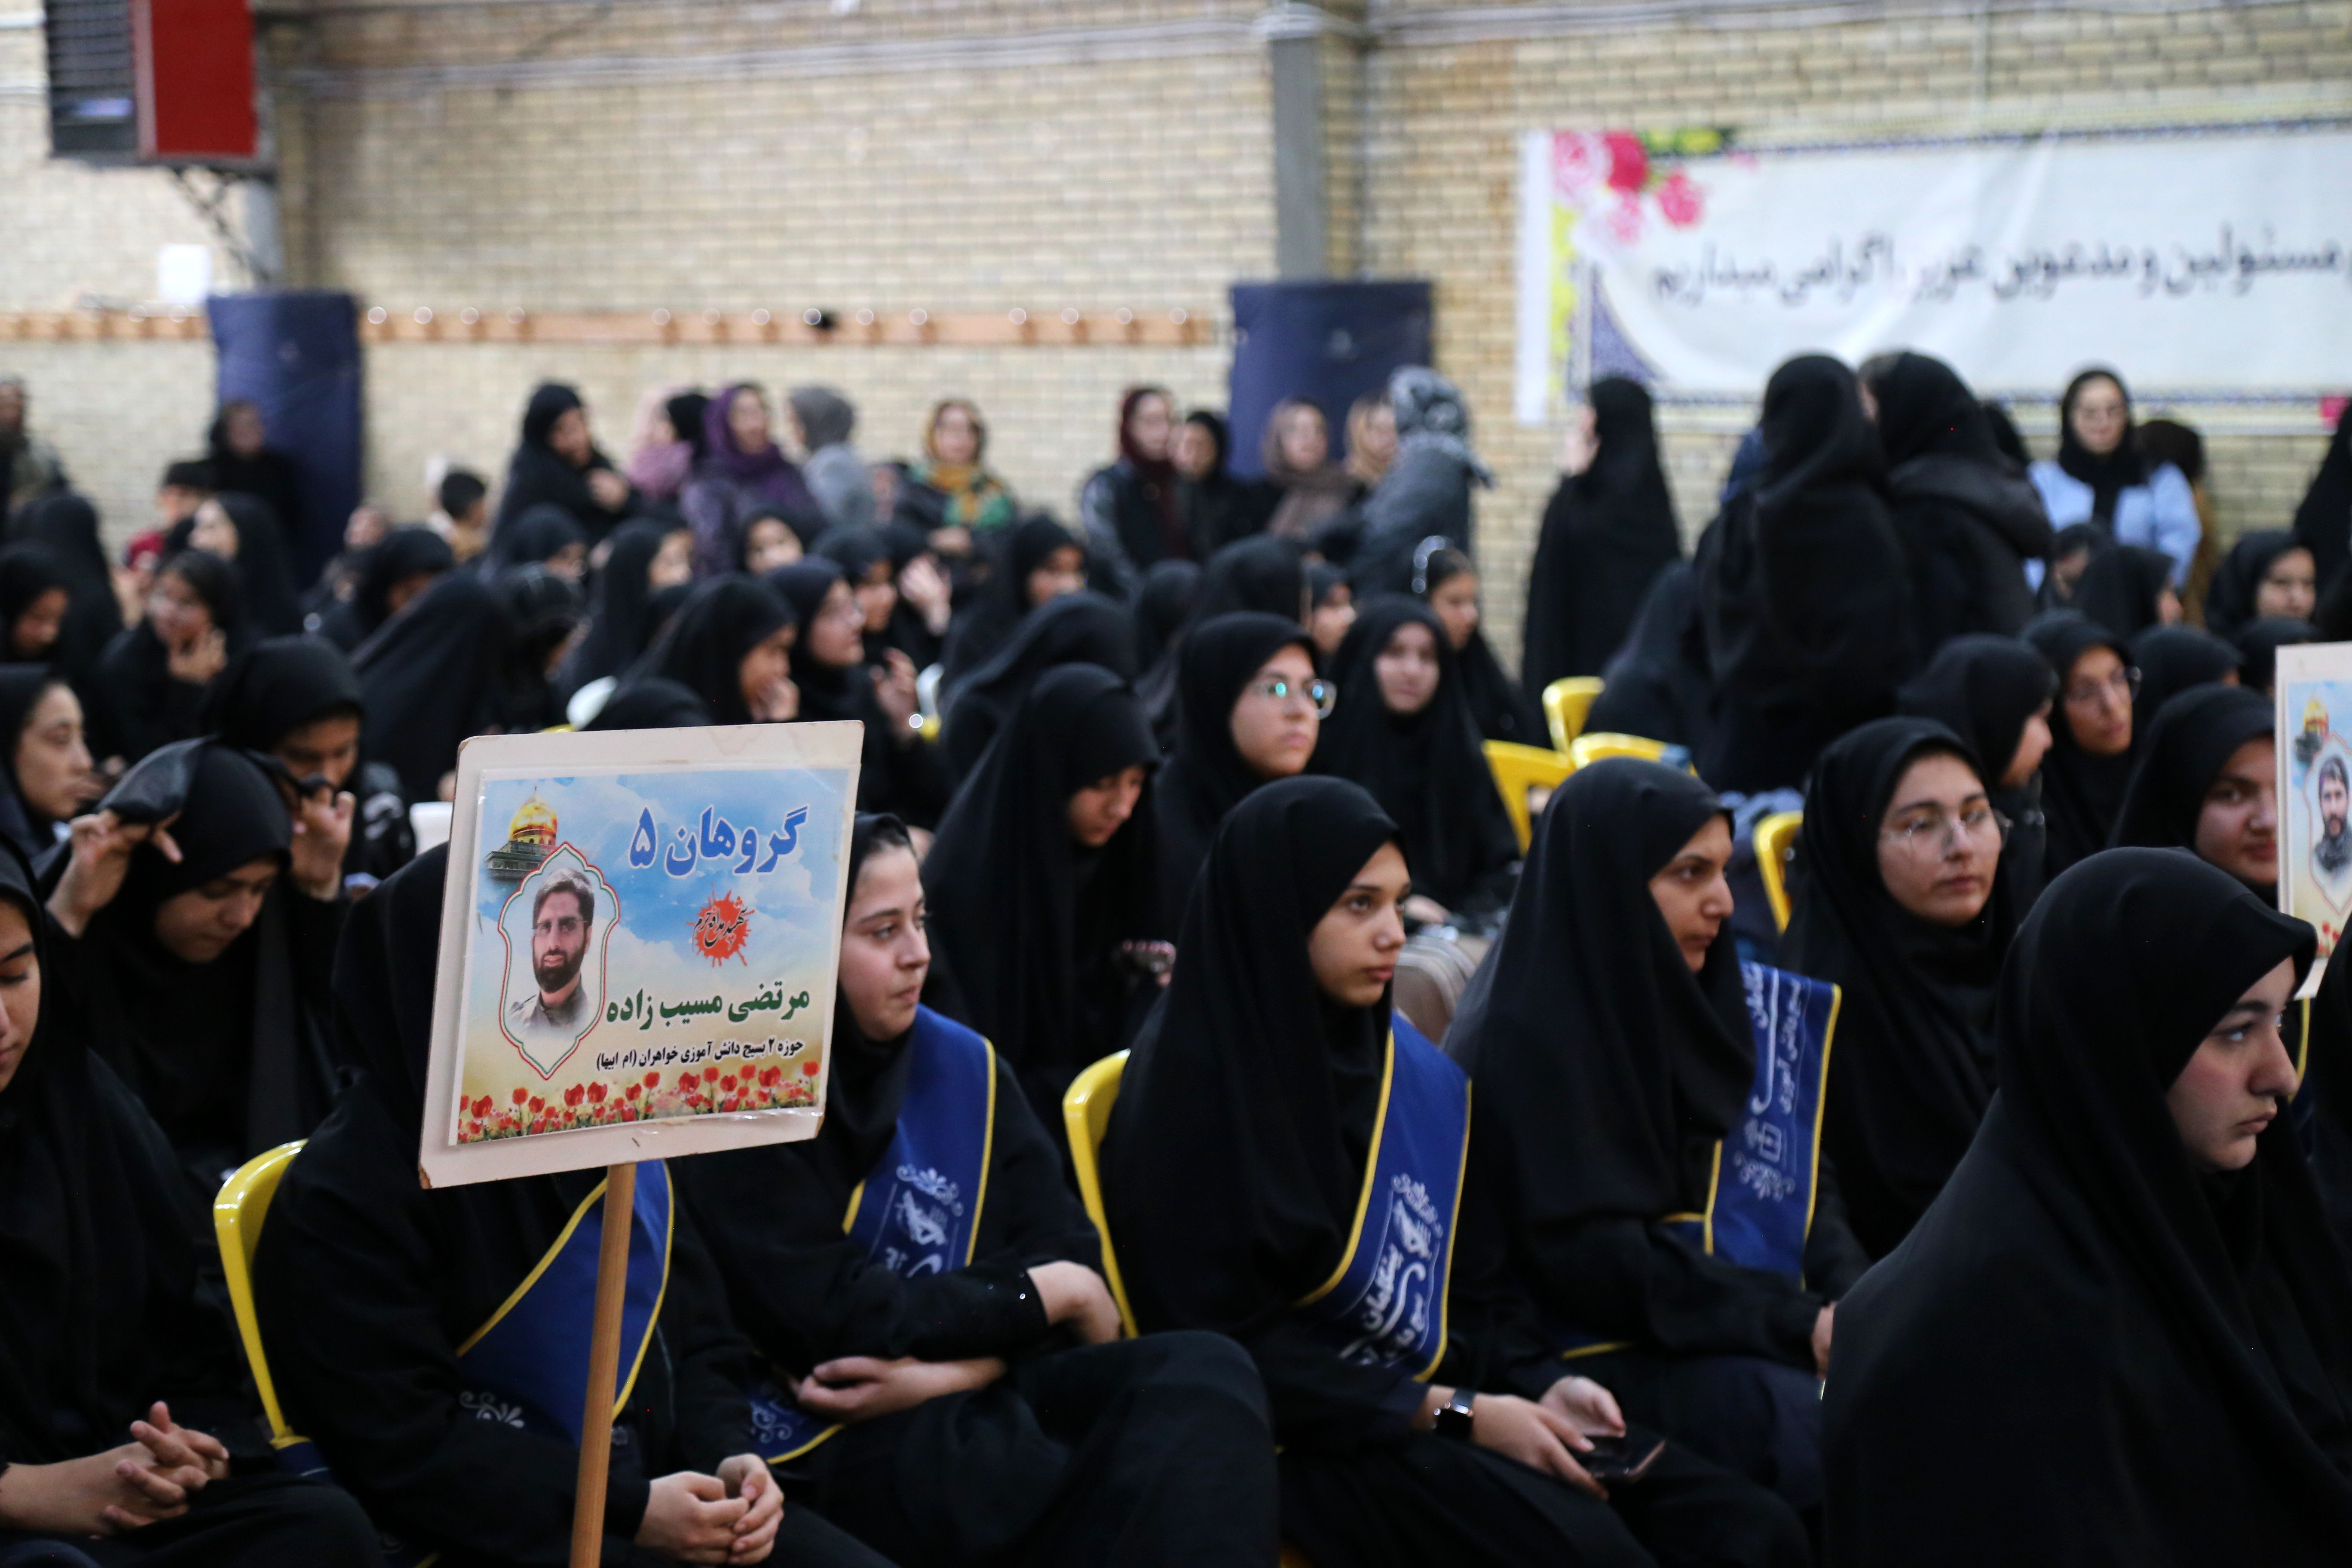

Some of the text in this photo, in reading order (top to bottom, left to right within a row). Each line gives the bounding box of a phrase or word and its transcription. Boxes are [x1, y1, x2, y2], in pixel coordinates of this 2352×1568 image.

[629, 804, 808, 877] گروهان ۵
[723, 895, 748, 944] شهید
[606, 981, 810, 1031] مرتضی مسیب زاده
[639, 1045, 678, 1067] خواهران
[680, 1040, 713, 1063] آموزی
[714, 1040, 740, 1060] دانش
[742, 1043, 766, 1059] بسیج
[778, 1040, 803, 1057] حوزه
